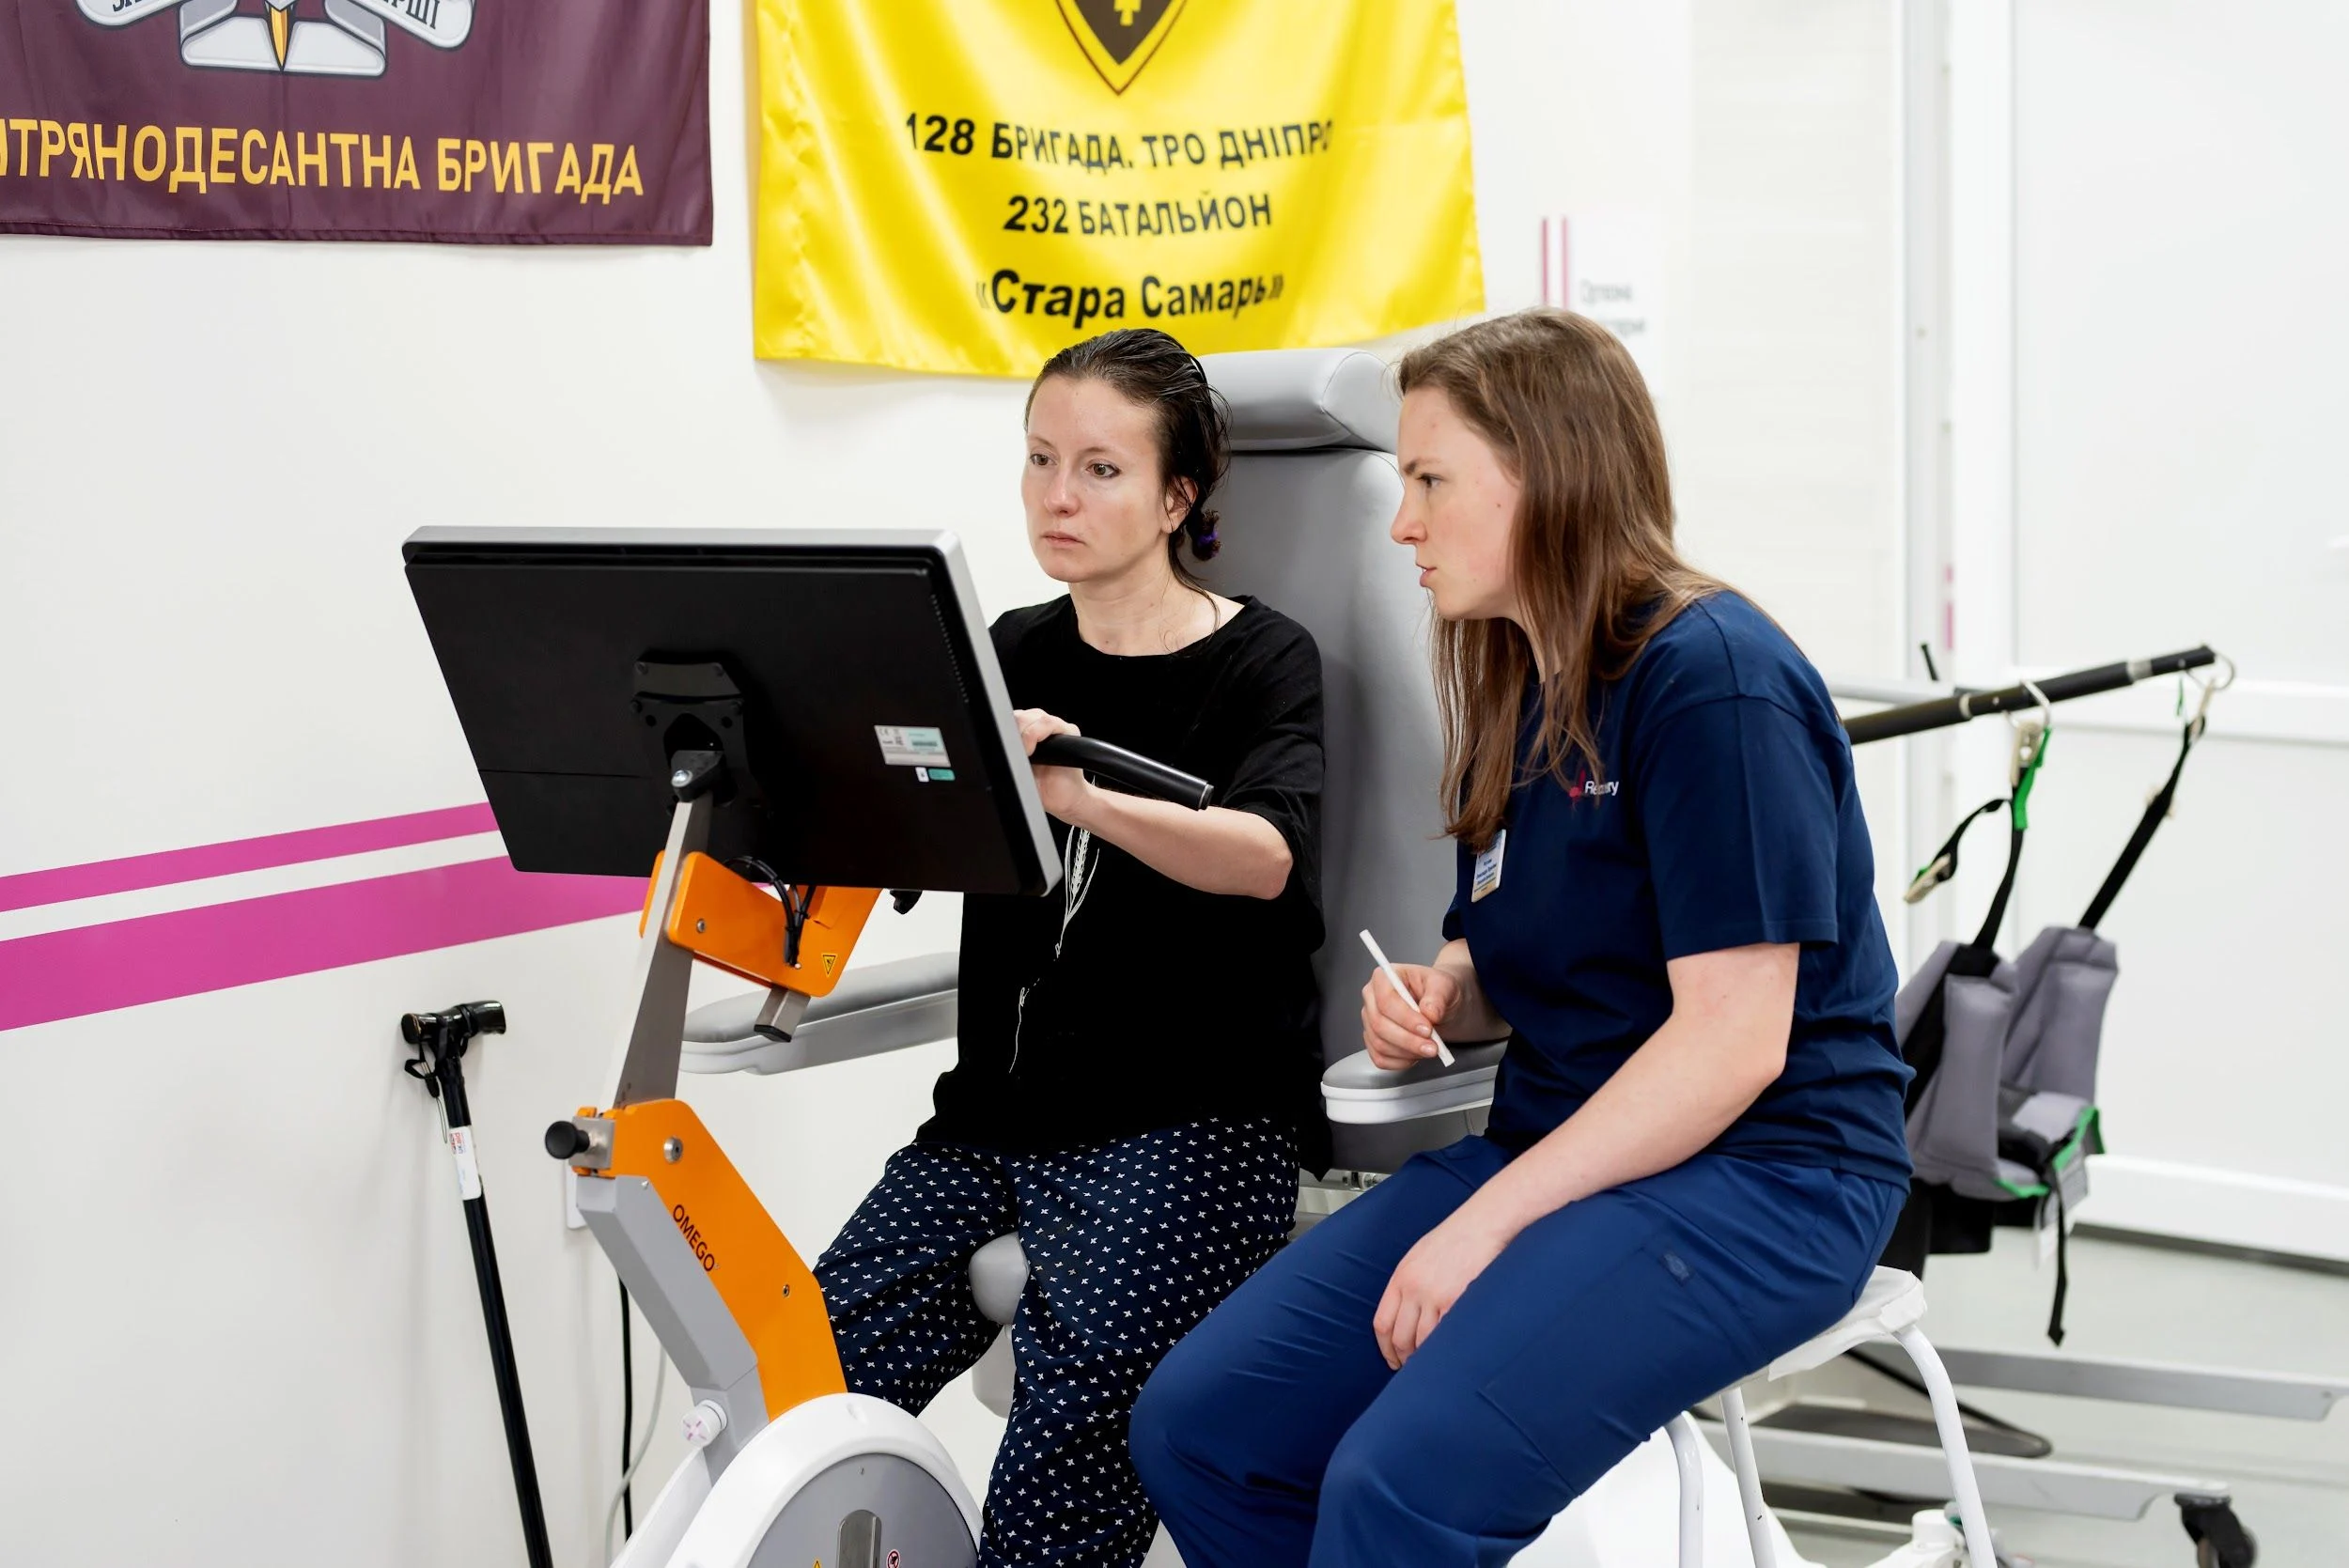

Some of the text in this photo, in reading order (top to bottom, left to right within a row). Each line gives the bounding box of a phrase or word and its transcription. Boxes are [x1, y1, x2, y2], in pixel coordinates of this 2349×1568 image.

[0, 117, 644, 205] ТРЯНОДЕСАНТНА БРИГАДА
[906, 112, 975, 156] 128
[1141, 132, 1206, 168] ТРО
[1003, 189, 1272, 237] 232 БАТАЛЬЙОН
[672, 1203, 715, 1272] OMEGO
